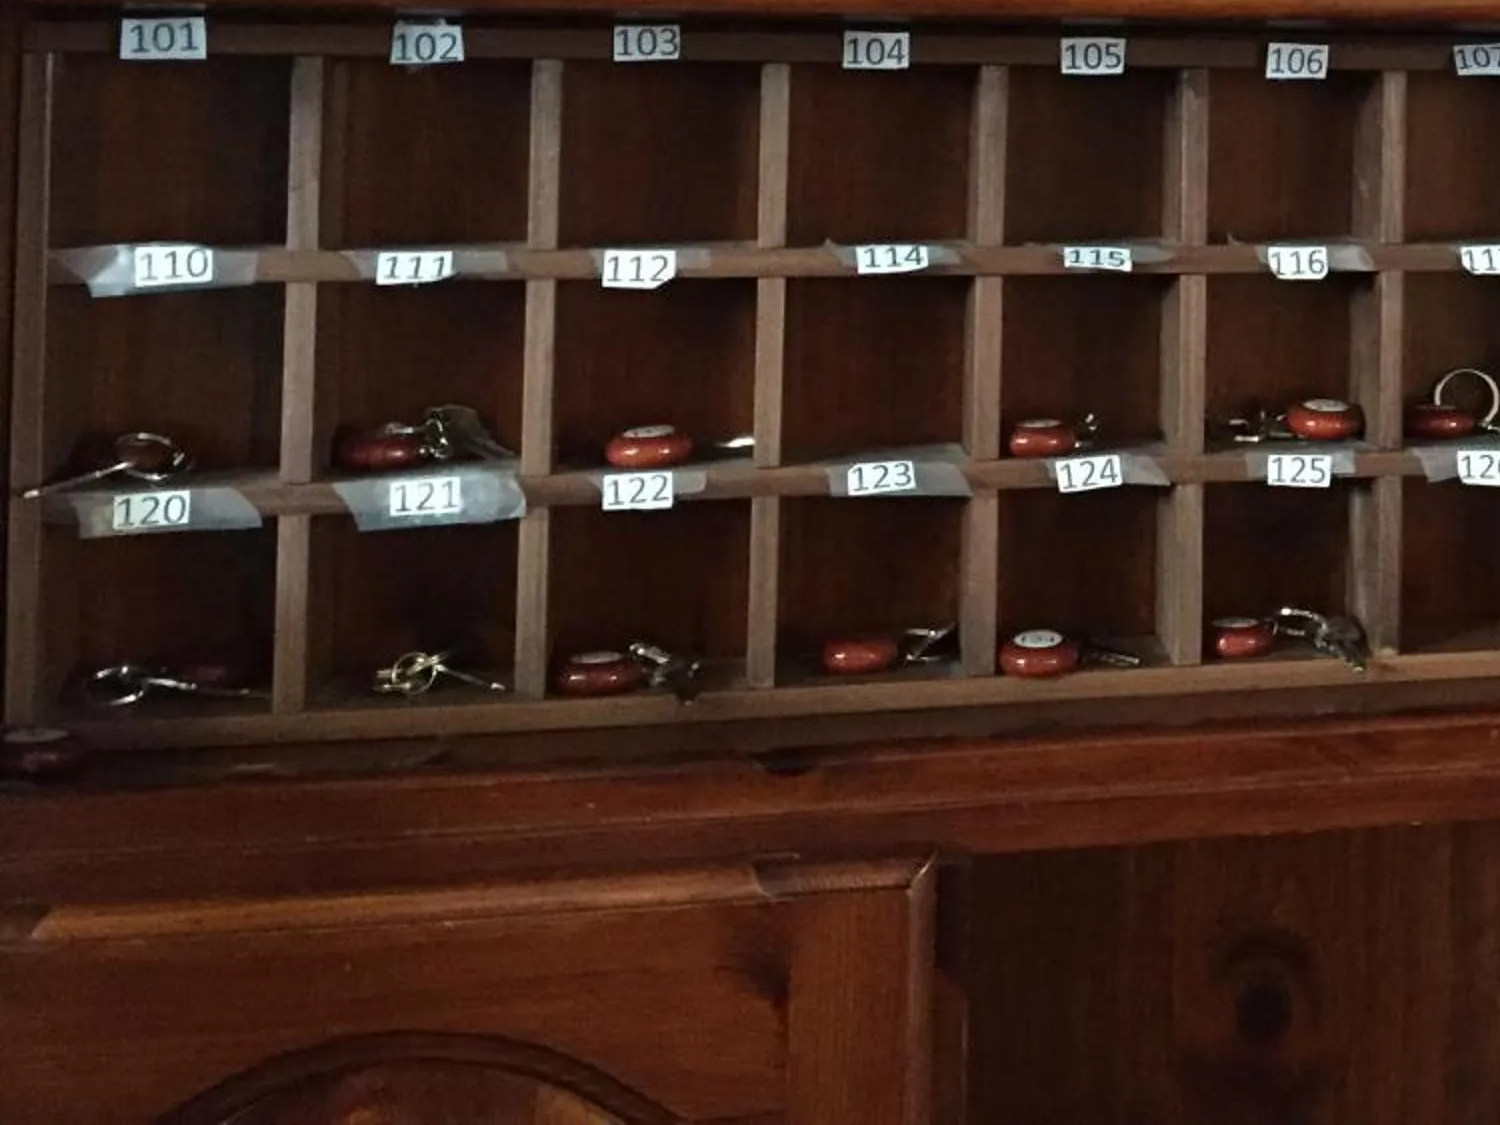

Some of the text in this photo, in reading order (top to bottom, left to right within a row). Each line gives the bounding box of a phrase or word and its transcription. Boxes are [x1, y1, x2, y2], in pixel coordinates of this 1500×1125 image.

[130, 22, 199, 54] 101
[395, 32, 458, 62] 102
[616, 28, 678, 57] 103
[846, 37, 907, 65] 104
[1064, 43, 1123, 70] 105
[1270, 48, 1324, 75] 106
[139, 249, 209, 281] 110
[383, 255, 450, 279] 111
[607, 255, 669, 282] 112
[864, 246, 923, 268] 114
[1069, 249, 1125, 267] 115
[1272, 250, 1325, 275] 116
[852, 463, 912, 491] 123
[1058, 458, 1120, 490] 124
[1268, 456, 1330, 484] 125
[394, 479, 459, 514] 121
[606, 474, 670, 504] 122
[117, 495, 187, 527] 120
